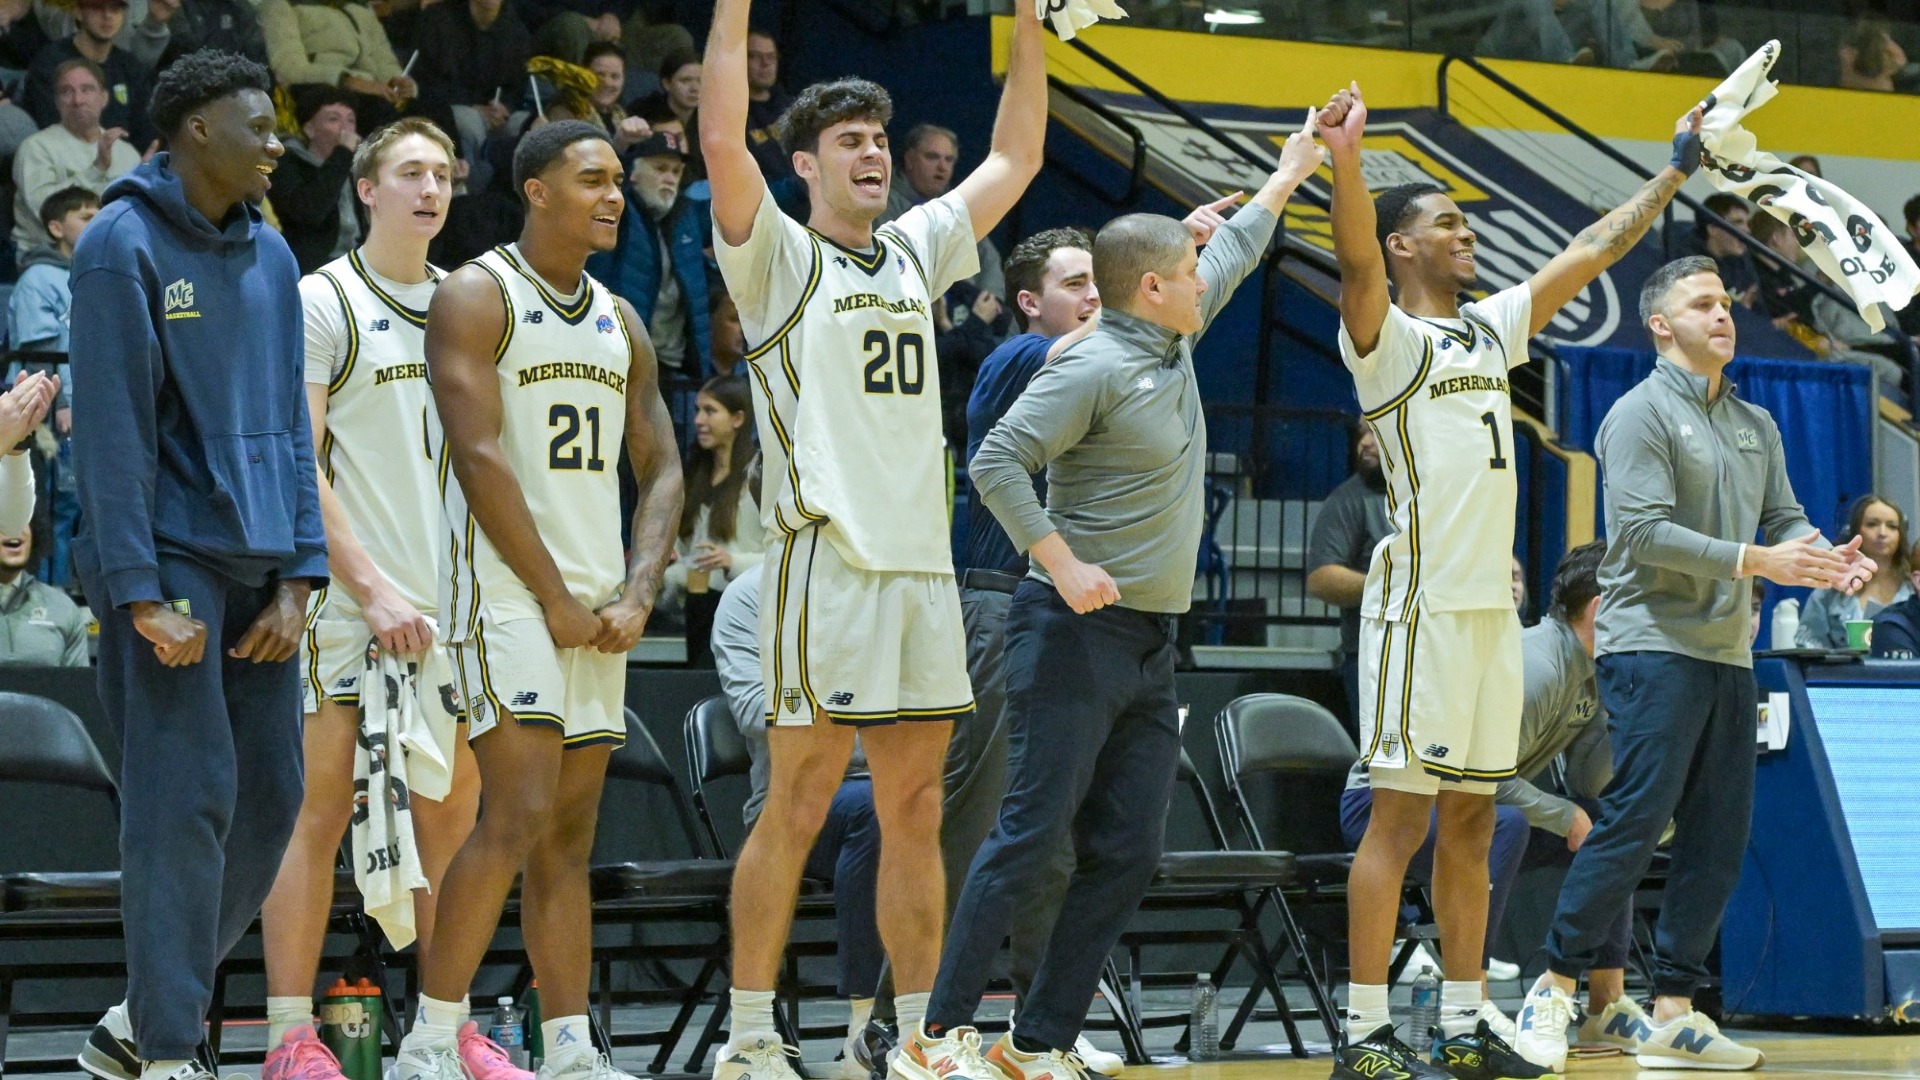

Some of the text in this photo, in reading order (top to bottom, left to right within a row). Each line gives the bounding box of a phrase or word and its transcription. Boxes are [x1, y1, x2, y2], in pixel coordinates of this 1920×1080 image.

[164, 278, 194, 312] MC
[833, 292, 928, 321] MERMA
[517, 361, 626, 396] MERRIMACK
[862, 328, 926, 396] 20
[547, 403, 605, 472] 21
[1480, 410, 1508, 471] 1
